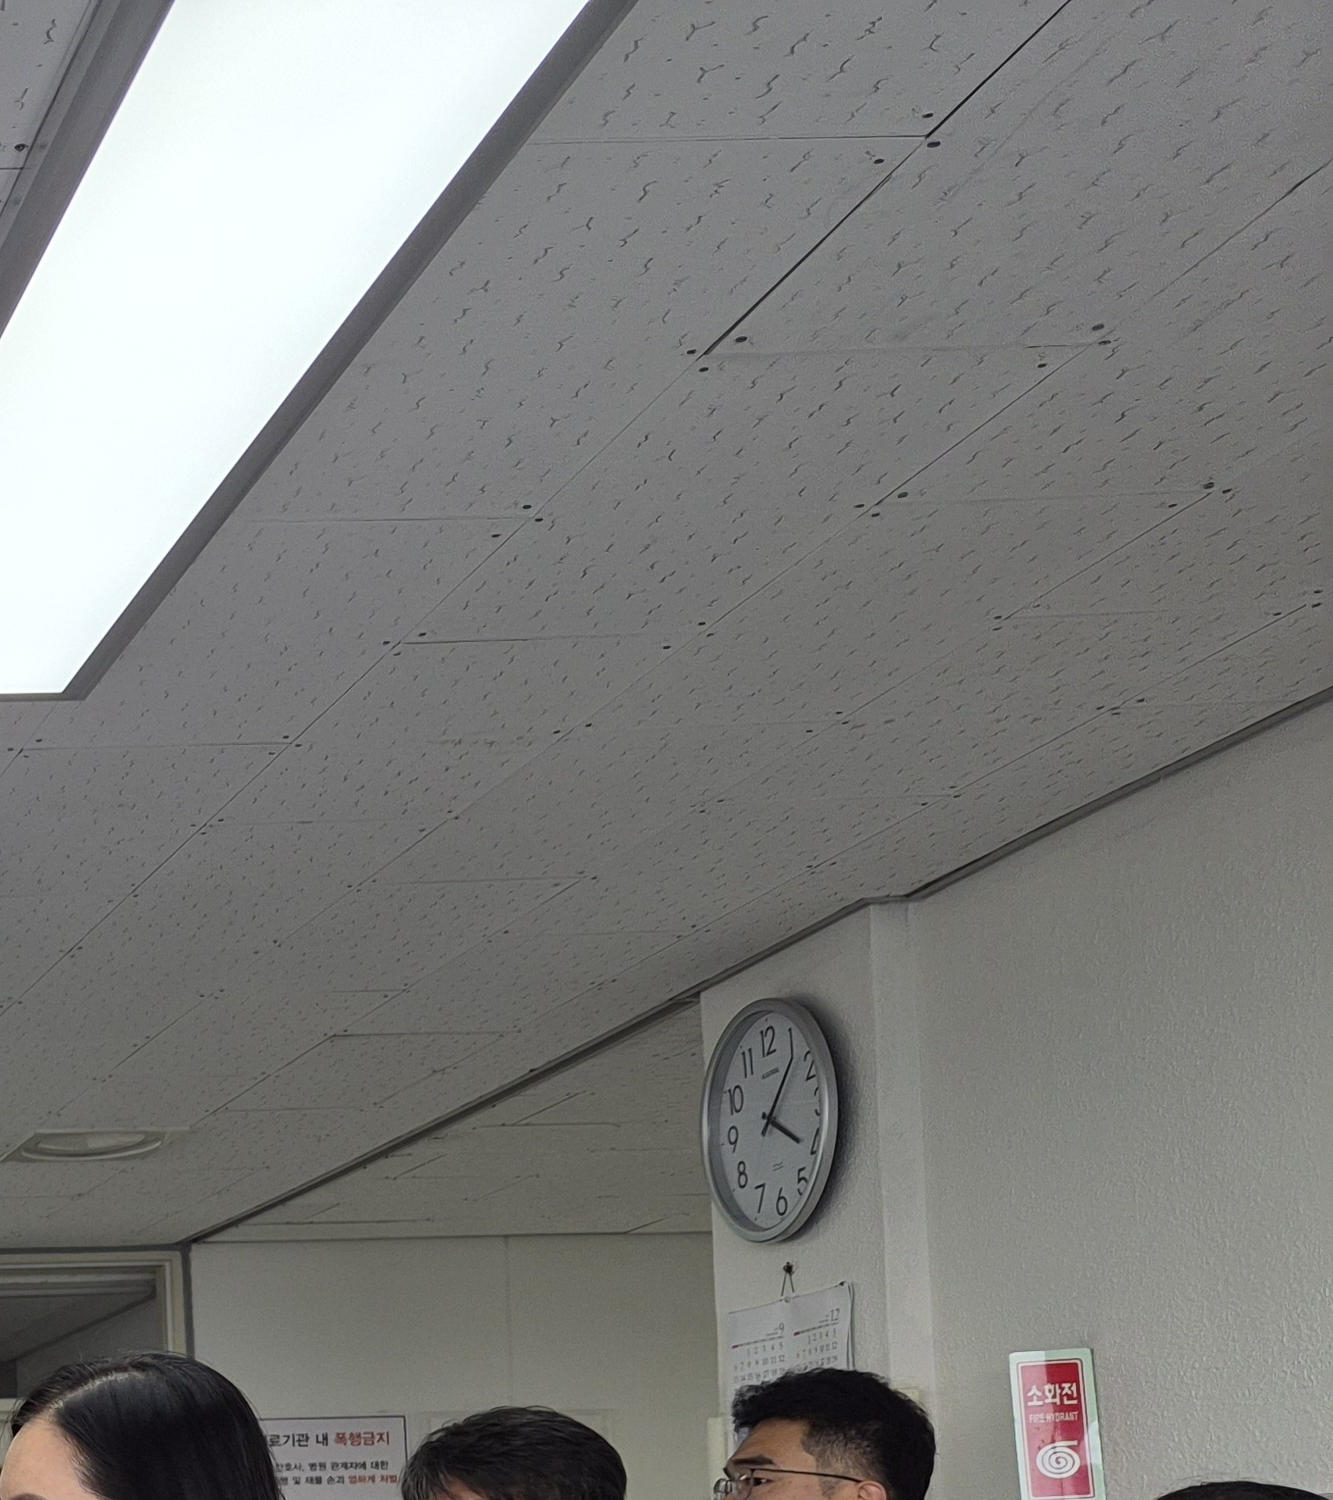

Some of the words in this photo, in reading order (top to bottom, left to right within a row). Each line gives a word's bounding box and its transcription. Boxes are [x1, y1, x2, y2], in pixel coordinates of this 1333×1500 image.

[760, 1026, 777, 1058] 12
[787, 1027, 794, 1058] 1
[741, 1047, 754, 1078] 11
[803, 1050, 817, 1081] 2
[728, 1085, 744, 1115] 10
[727, 1125, 739, 1153] 9
[737, 1160, 748, 1188] 8
[797, 1167, 808, 1196] 5
[754, 1183, 766, 1214] 7
[776, 1187, 788, 1216] 6
[779, 1322, 785, 1335] 9
[830, 1308, 840, 1321] 12
[1027, 1382, 1078, 1406] 소화전
[1029, 1413, 1045, 1423] FIRE
[1046, 1411, 1078, 1422] HYDRANT
[265, 1433, 310, 1447] 료기관
[315, 1432, 329, 1447] 내
[334, 1431, 390, 1447] 폭행금지
[370, 1460, 389, 1471] 대한
